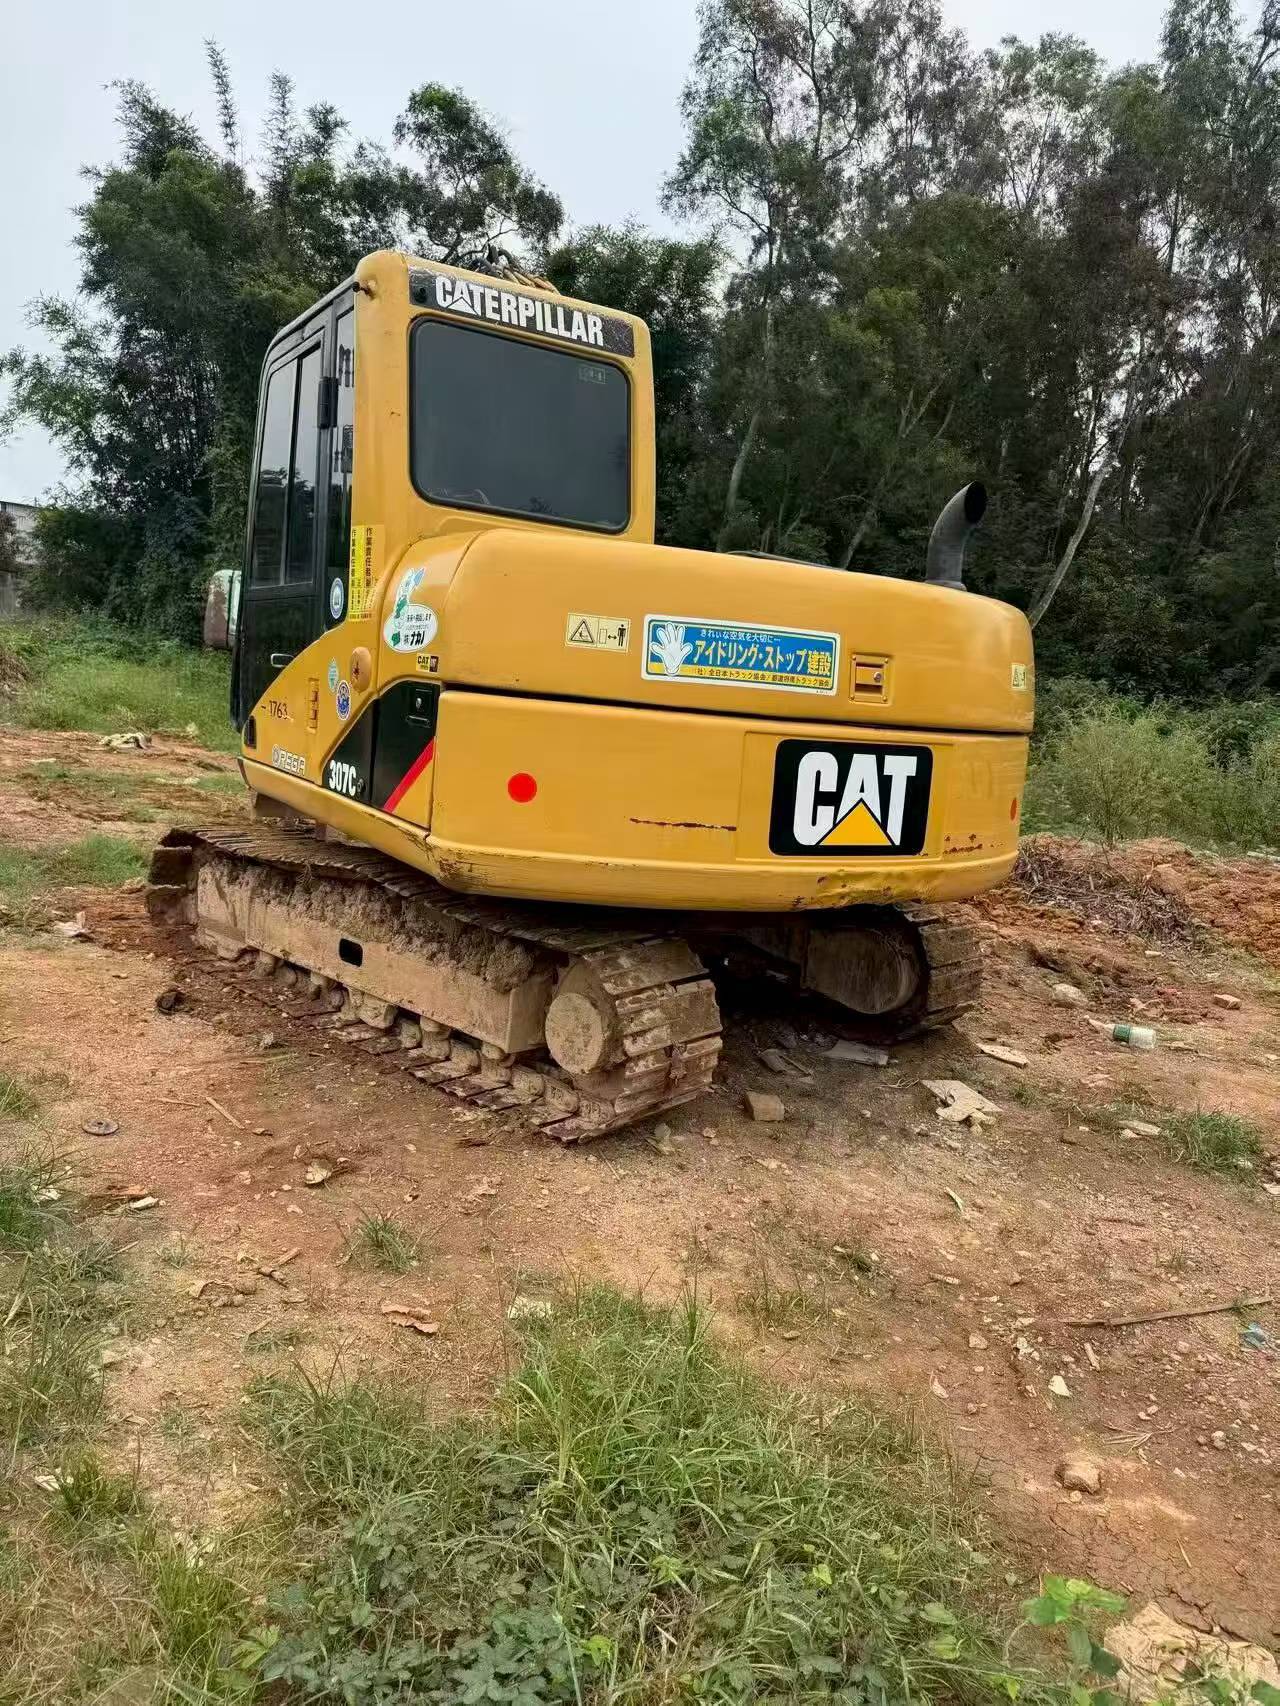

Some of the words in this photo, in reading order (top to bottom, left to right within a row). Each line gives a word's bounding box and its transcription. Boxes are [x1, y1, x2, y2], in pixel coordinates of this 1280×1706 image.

[435, 277, 604, 346] CATERPILLAR
[417, 656, 429, 664] CAT
[329, 760, 357, 796] 307C
[793, 751, 918, 846] CAT
